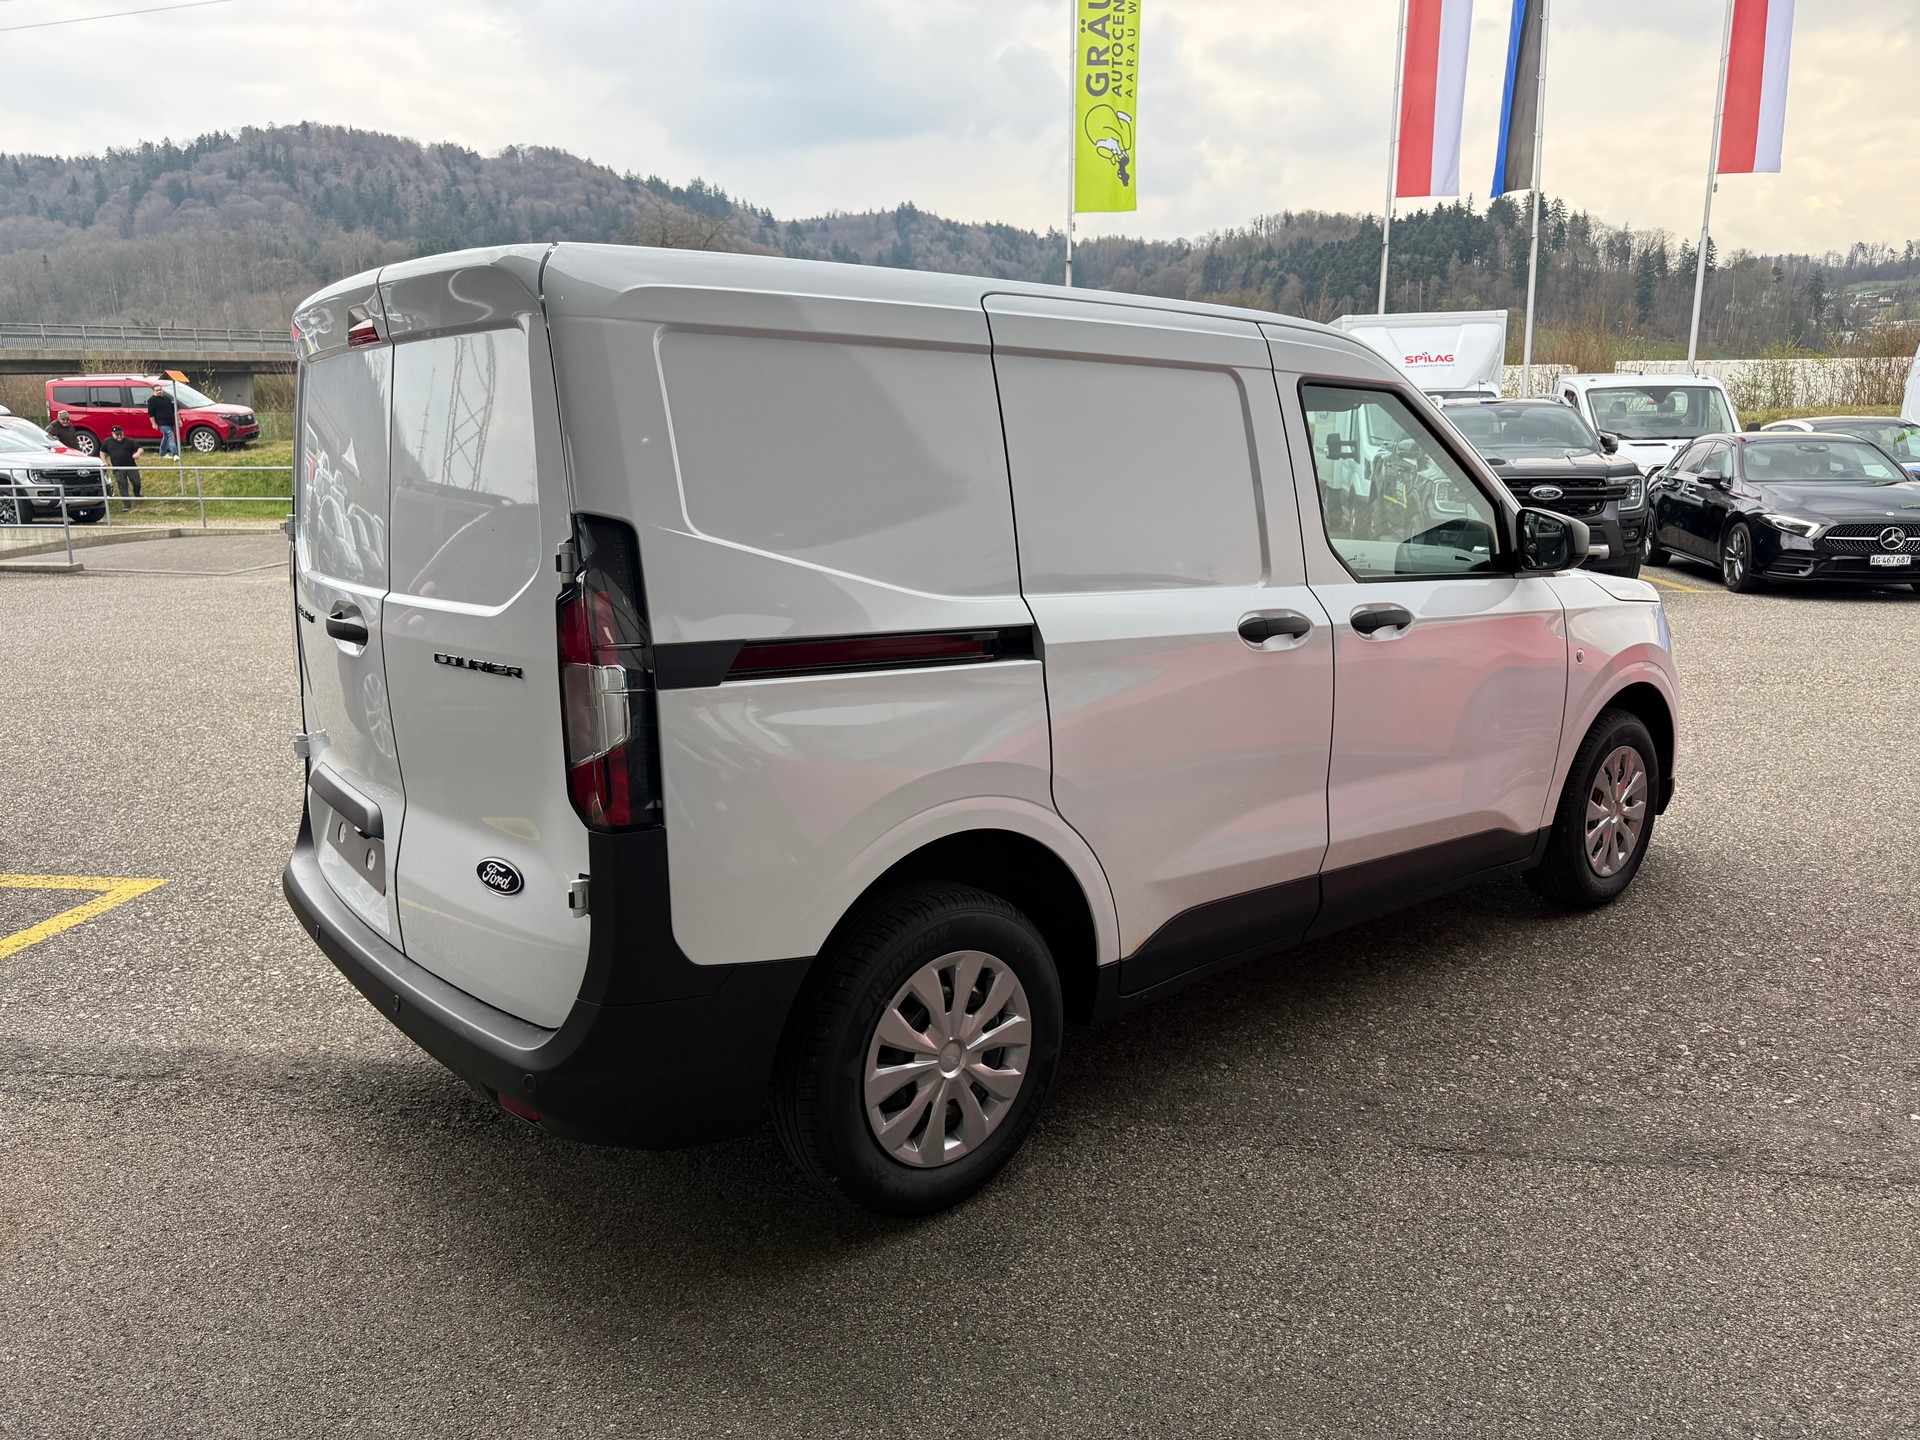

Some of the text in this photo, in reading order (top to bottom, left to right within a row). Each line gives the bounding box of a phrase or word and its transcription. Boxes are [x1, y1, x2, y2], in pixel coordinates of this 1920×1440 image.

[1112, 0, 1125, 98] AUTOCEN
[1125, 28, 1136, 98] AARAU
[434, 652, 523, 679] COURIER
